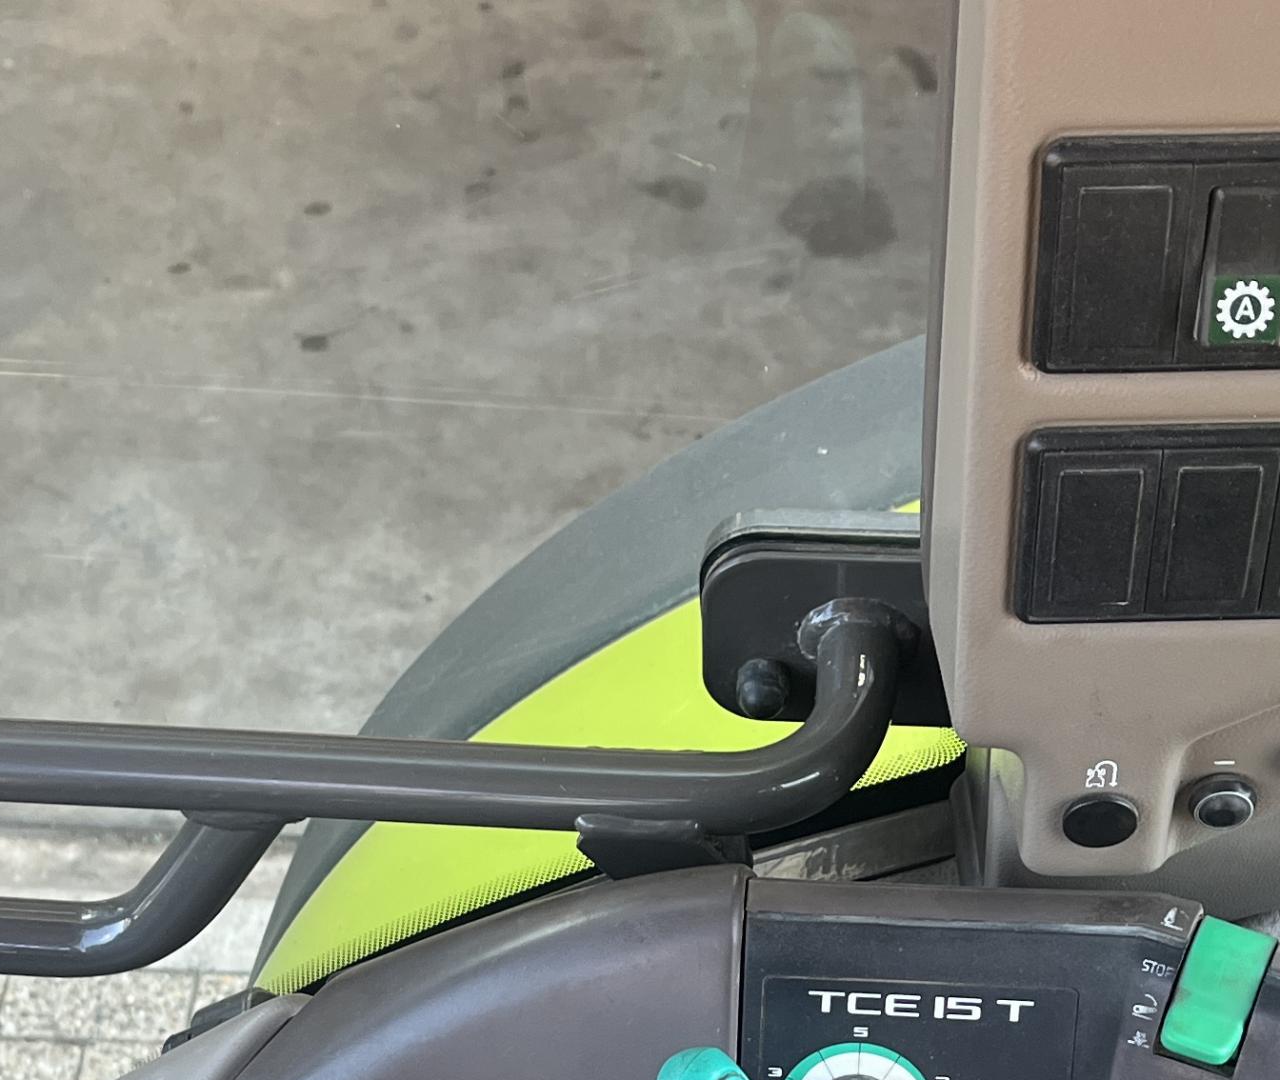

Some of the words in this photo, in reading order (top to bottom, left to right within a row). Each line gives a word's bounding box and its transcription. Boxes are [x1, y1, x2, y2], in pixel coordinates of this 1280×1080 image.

[808, 990, 922, 1018] TCE
[996, 999, 1035, 1023] T
[853, 1026, 869, 1038] 5
[767, 1067, 783, 1077] 3
